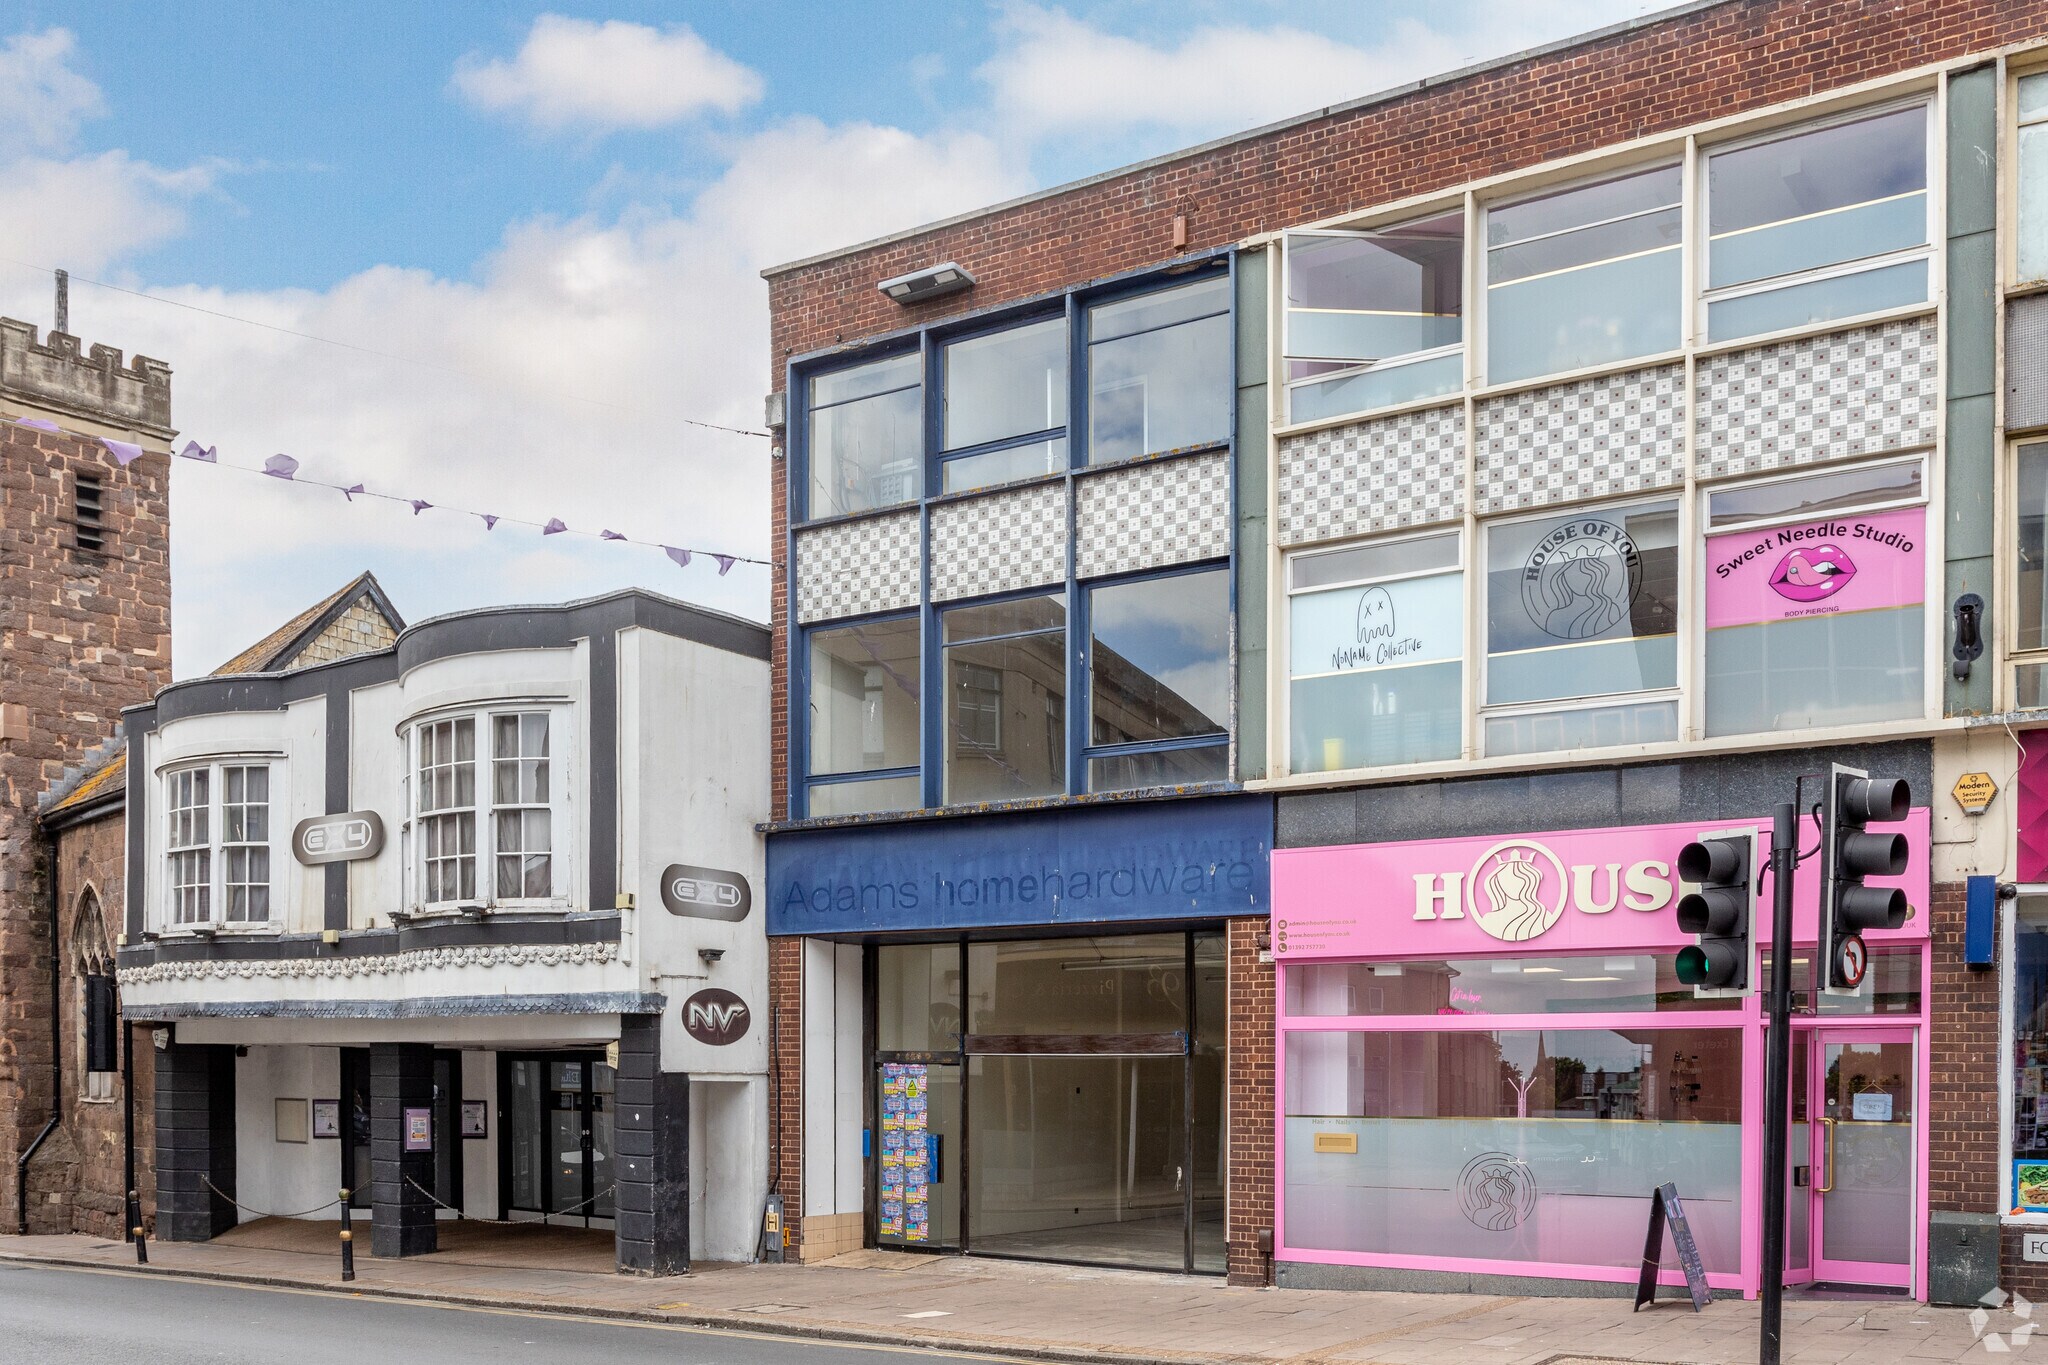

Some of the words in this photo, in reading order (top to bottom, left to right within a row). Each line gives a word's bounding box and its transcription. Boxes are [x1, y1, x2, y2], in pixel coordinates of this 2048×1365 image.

[1526, 525, 1577, 582] HOUSE
[1582, 522, 1610, 537] OF
[1611, 530, 1639, 568] YOU
[1715, 538, 1774, 579] Sweet
[1777, 522, 1848, 546] Needle
[1852, 523, 1914, 553] Studio
[1784, 609, 1804, 618] BODY
[1805, 605, 1840, 615] PIERCING
[1958, 782, 1990, 790] Modern
[782, 880, 919, 914] Adams
[690, 1002, 745, 1032] NV
